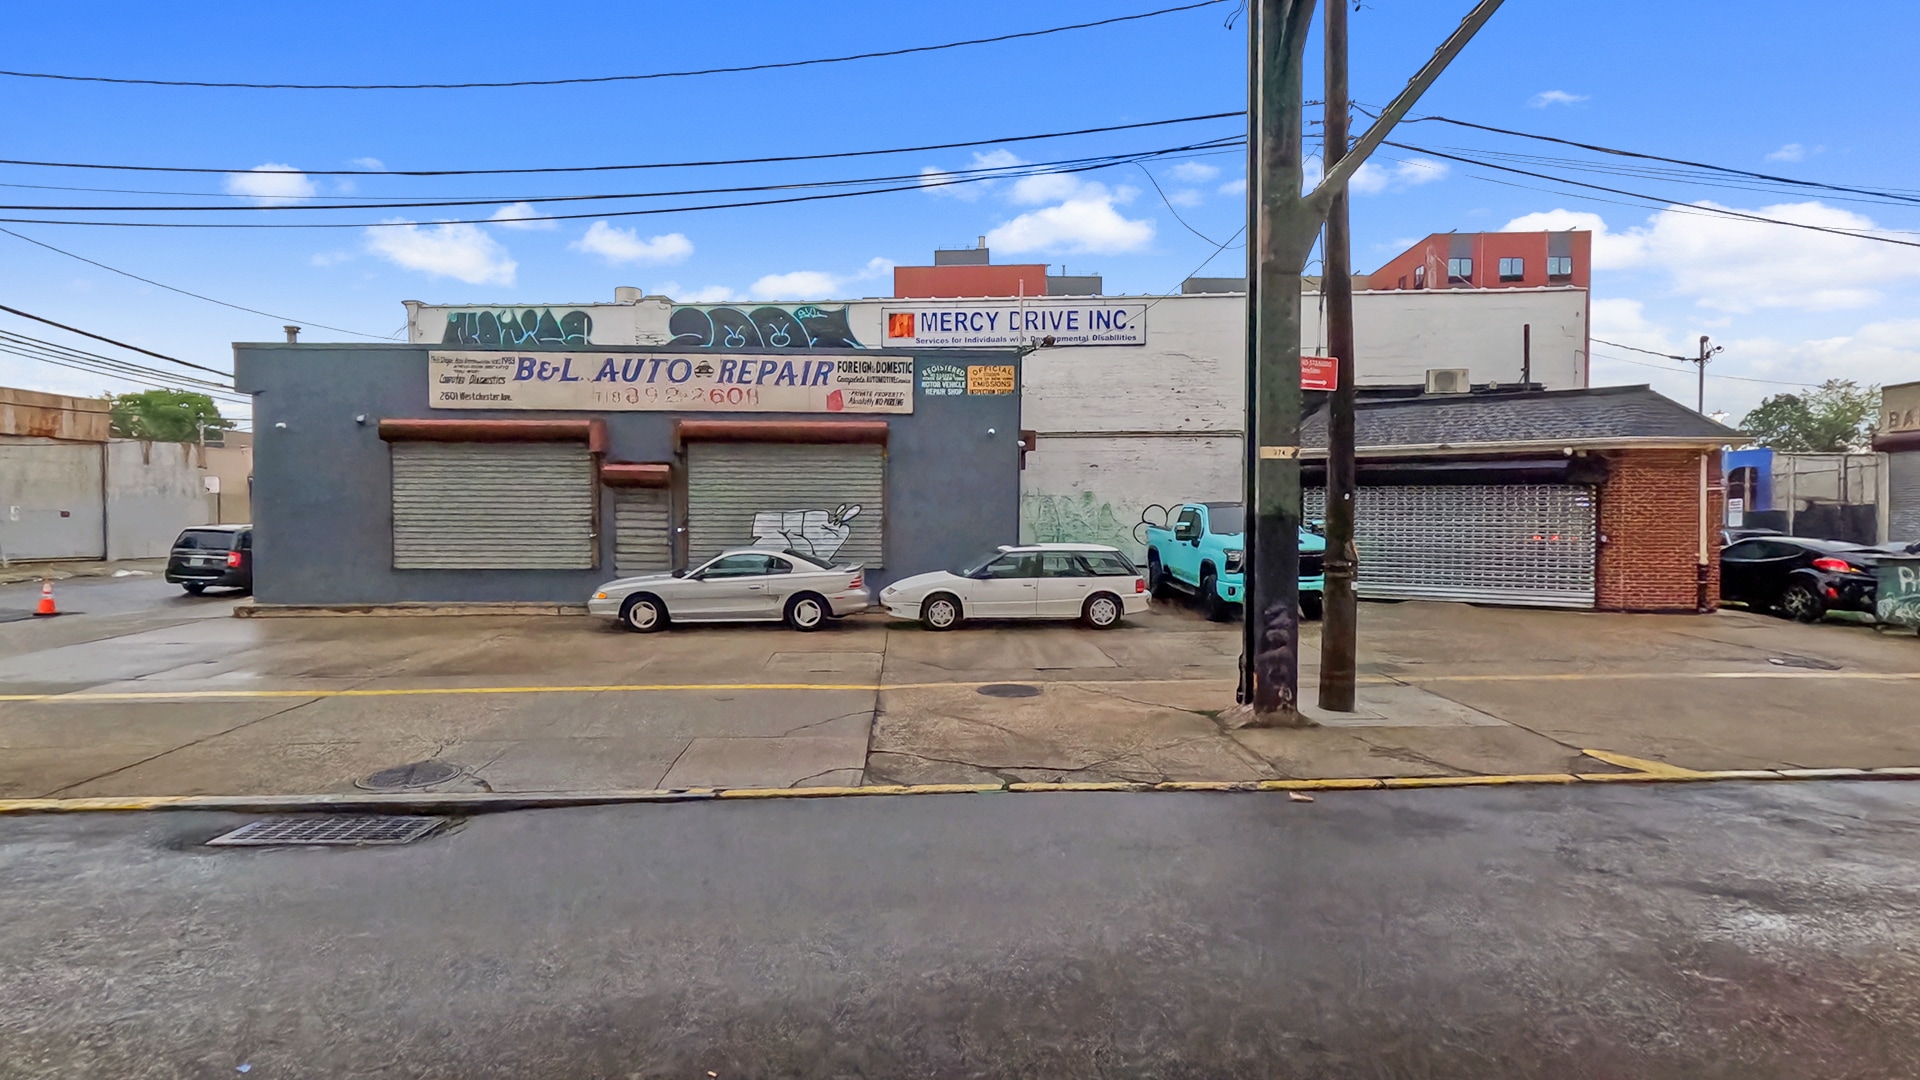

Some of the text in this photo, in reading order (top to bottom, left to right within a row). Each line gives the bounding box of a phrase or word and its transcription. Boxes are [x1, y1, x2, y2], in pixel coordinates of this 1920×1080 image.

[921, 309, 1135, 332] MERCY DRIVE INC.
[592, 358, 693, 384] AUTO
[717, 359, 834, 386] REPAIR
[837, 361, 872, 373] FOREIGN
[876, 361, 912, 374] DOMESTIC
[921, 365, 966, 377] REGISTERED
[972, 365, 1012, 376] OFFICIAL
[836, 375, 865, 385] Complete
[972, 380, 1011, 388] EMISSIONS
[925, 388, 963, 396] REPAIR SHOP
[875, 398, 884, 406] NO
